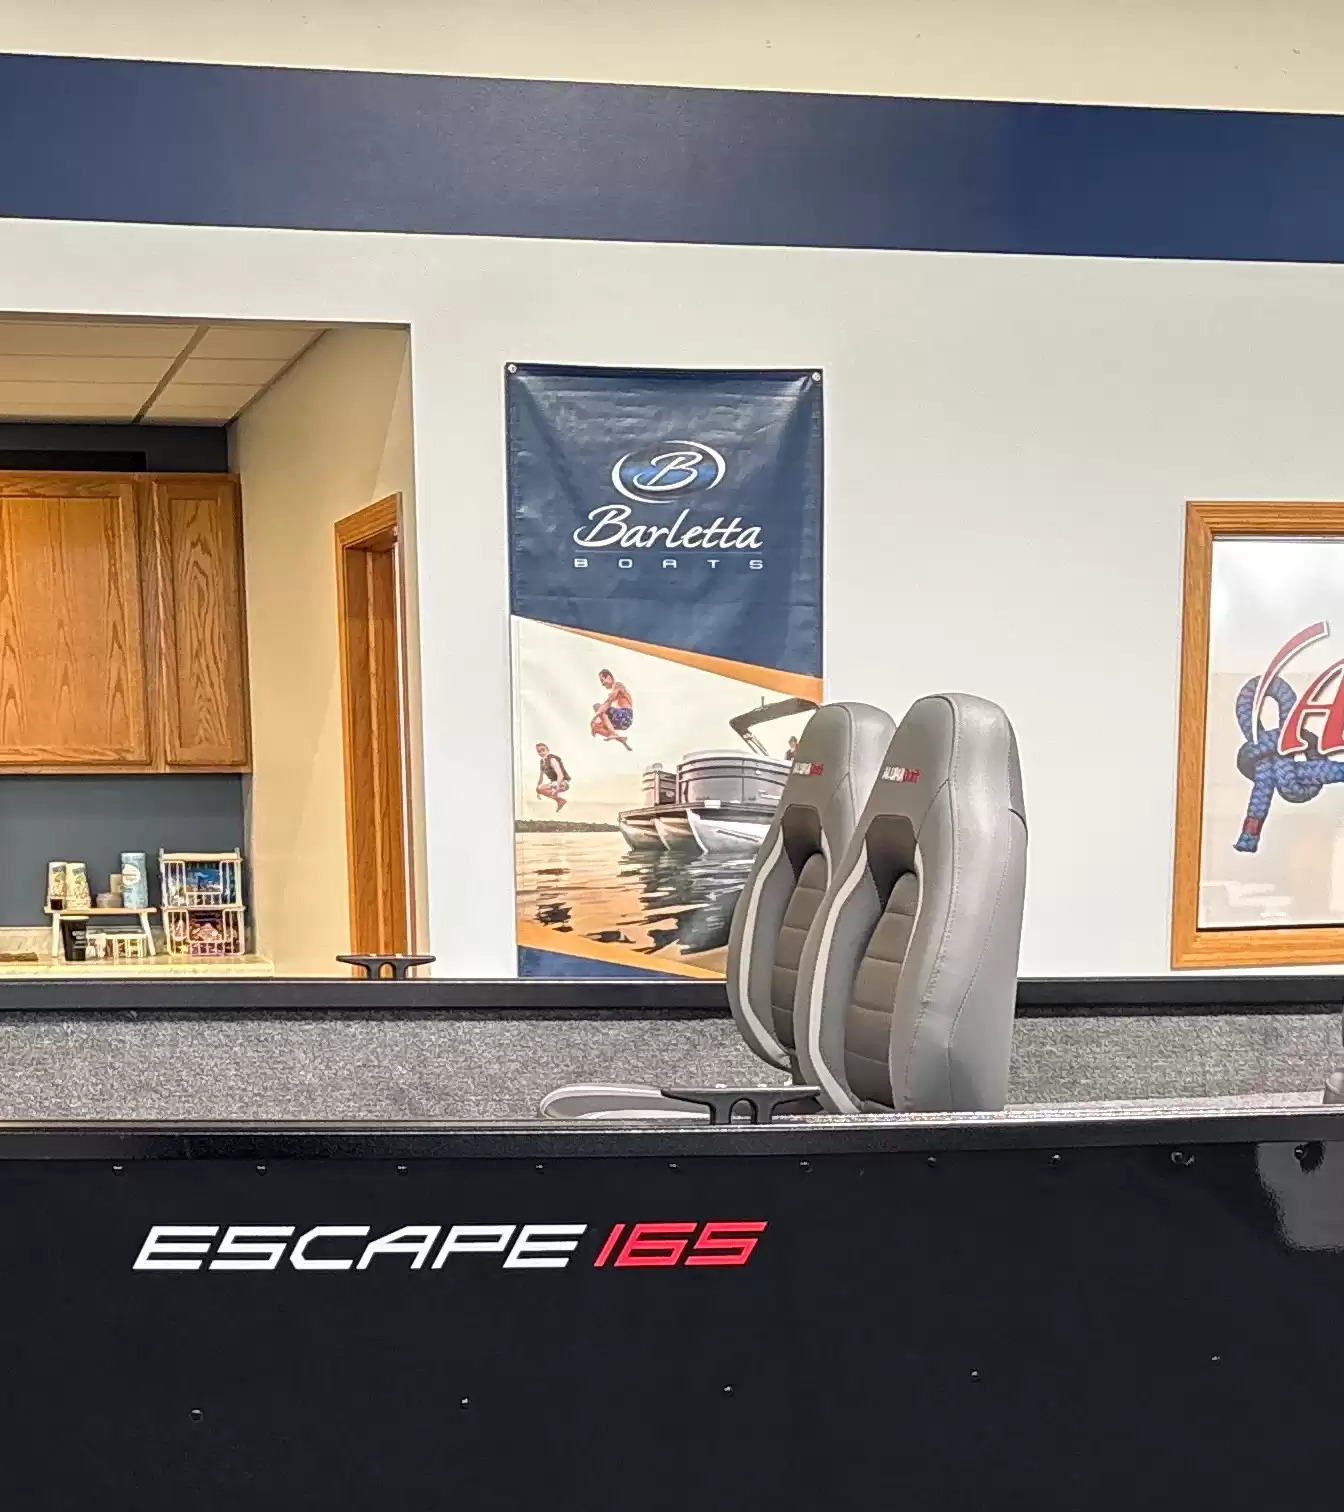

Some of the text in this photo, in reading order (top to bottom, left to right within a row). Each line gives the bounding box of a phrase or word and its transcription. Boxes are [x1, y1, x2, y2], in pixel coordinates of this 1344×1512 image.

[573, 504, 764, 549] Barletta
[573, 558, 764, 570] BOATS
[133, 1221, 768, 1270] ESCAPE 165
